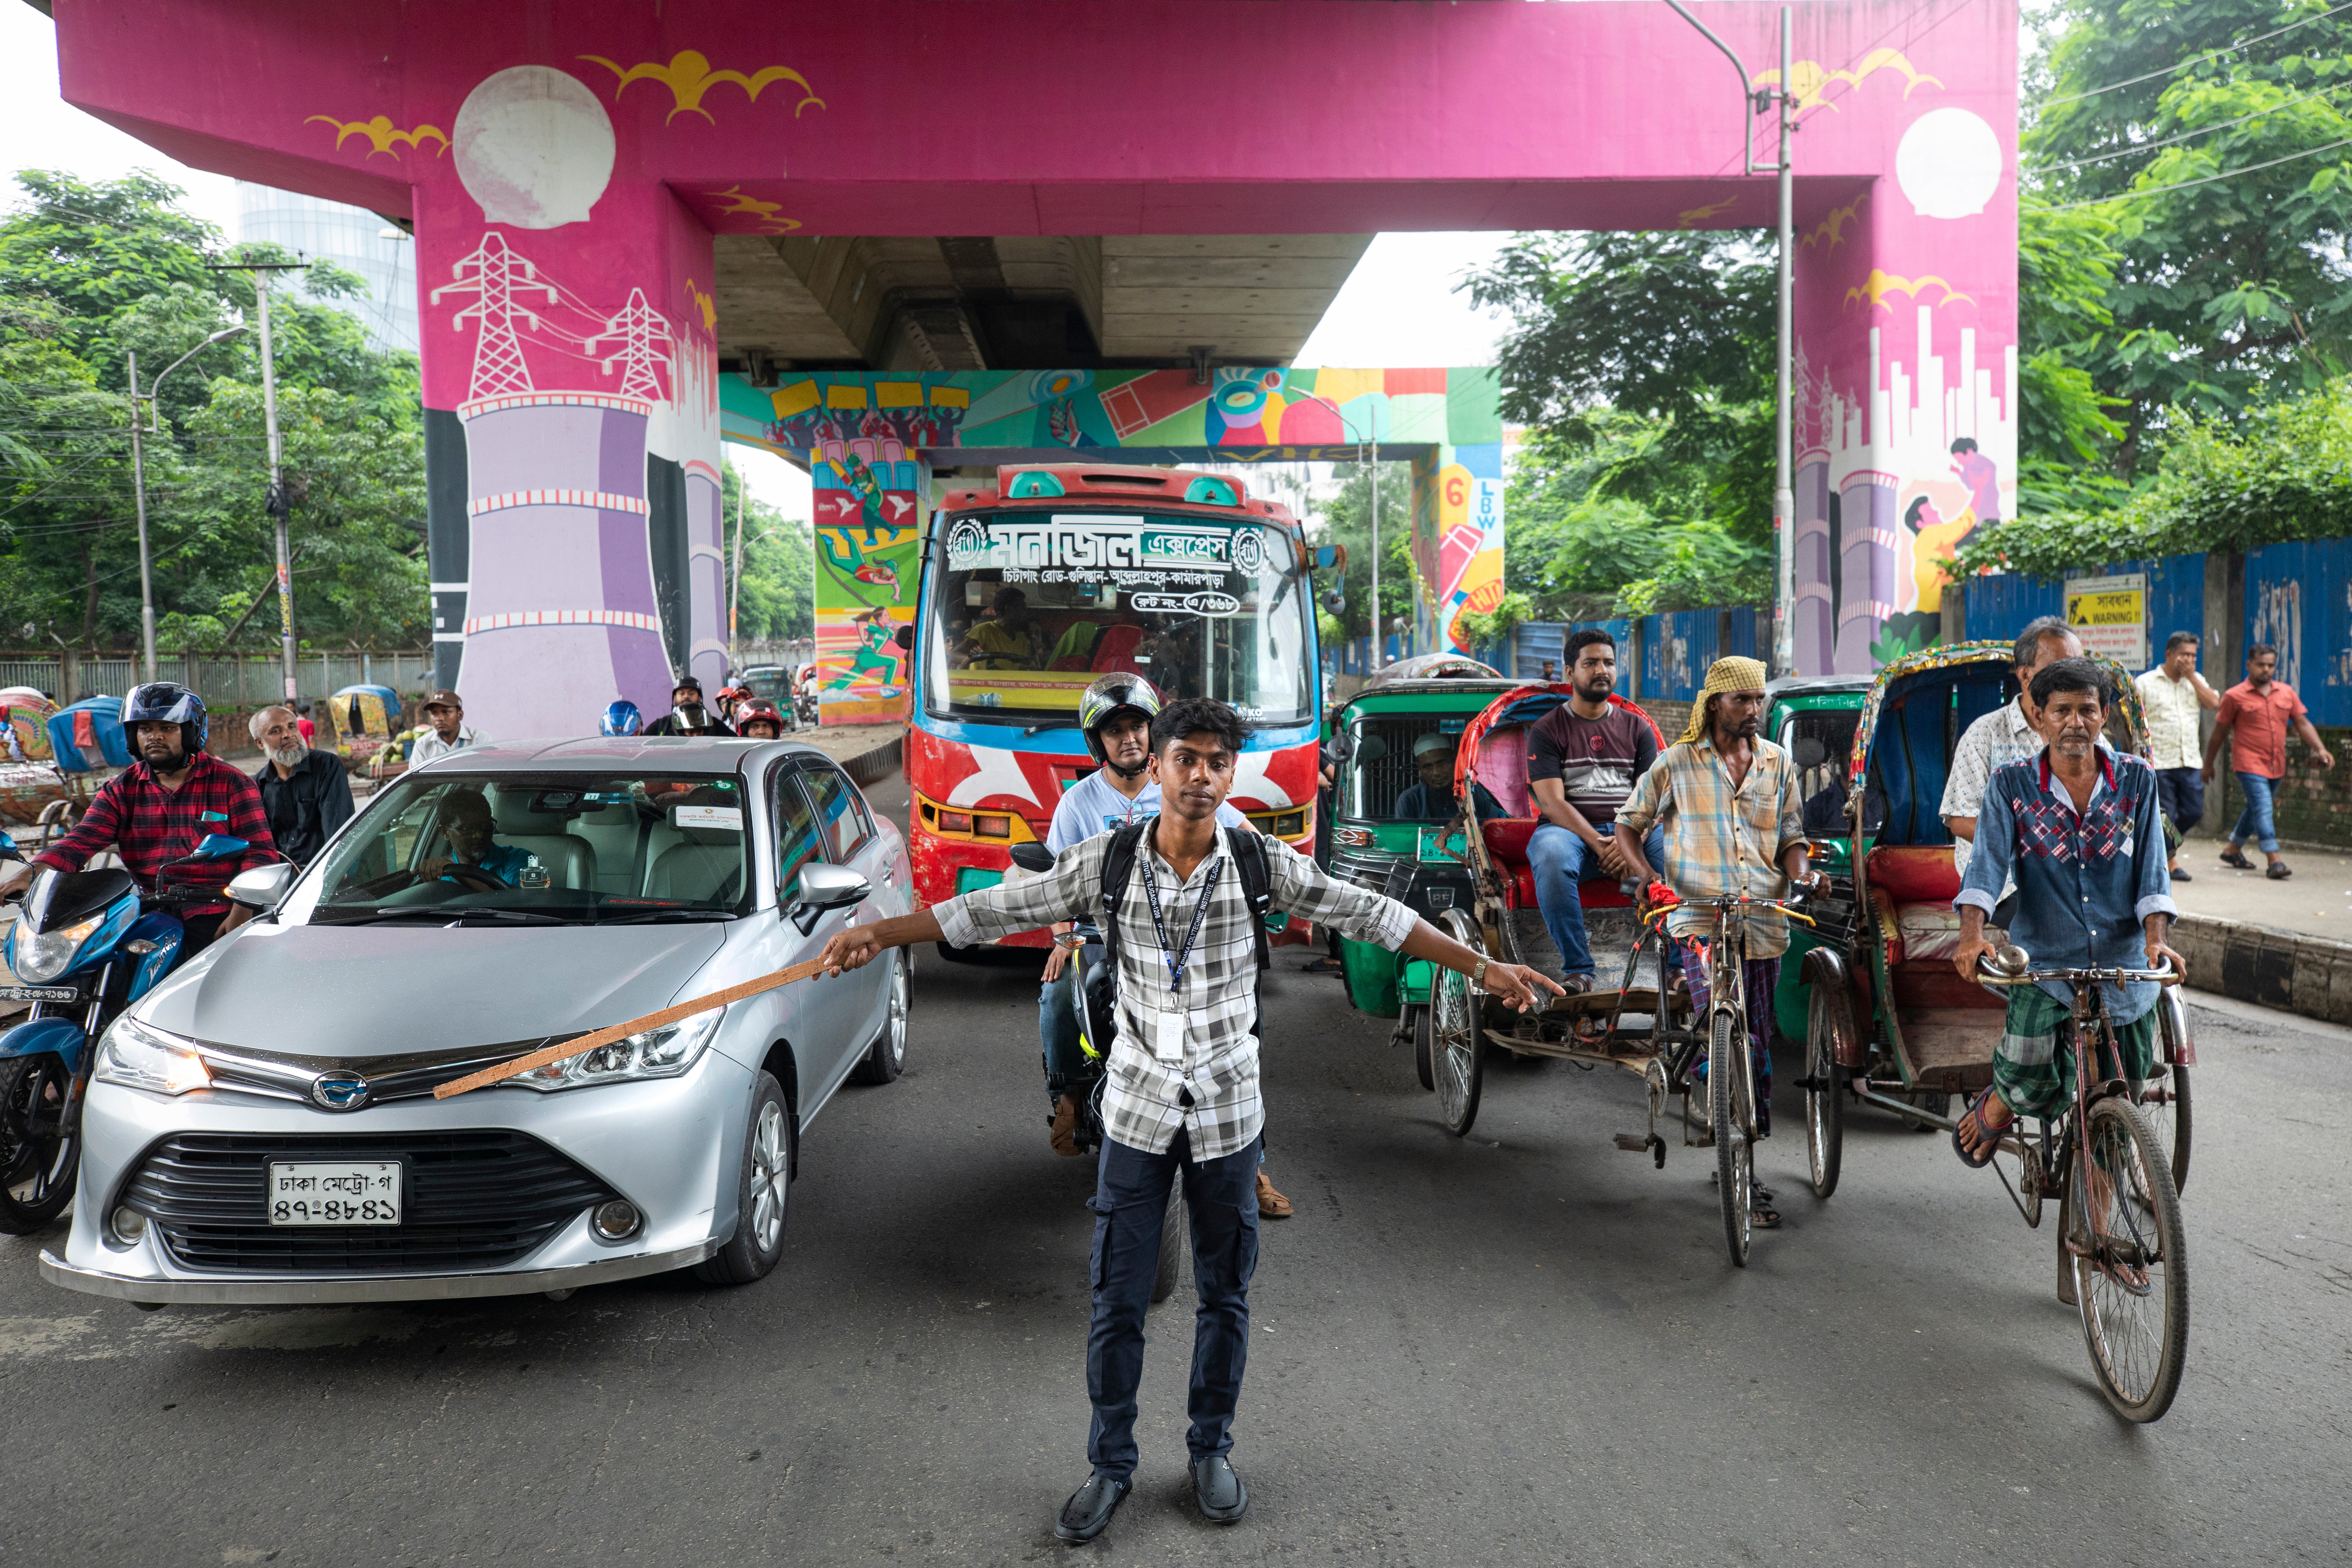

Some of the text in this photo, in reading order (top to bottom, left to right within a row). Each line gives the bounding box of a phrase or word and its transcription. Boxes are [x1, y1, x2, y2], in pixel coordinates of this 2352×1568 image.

[1446, 478, 1464, 506] 6
[988, 514, 1228, 567] মনজিল এক্সপ্রেস
[1003, 568, 1038, 583] চিটাগাং
[1137, 597, 1160, 608] রুট
[2093, 611, 2132, 624] WARNING
[1157, 923, 1166, 943] (Food)
[1180, 946, 1191, 965] DHAKA
[1187, 909, 1204, 945] POLYTECHNIC
[279, 1175, 317, 1191] ঢাকা
[274, 1199, 396, 1221] ৪৭-৪৮৪১
